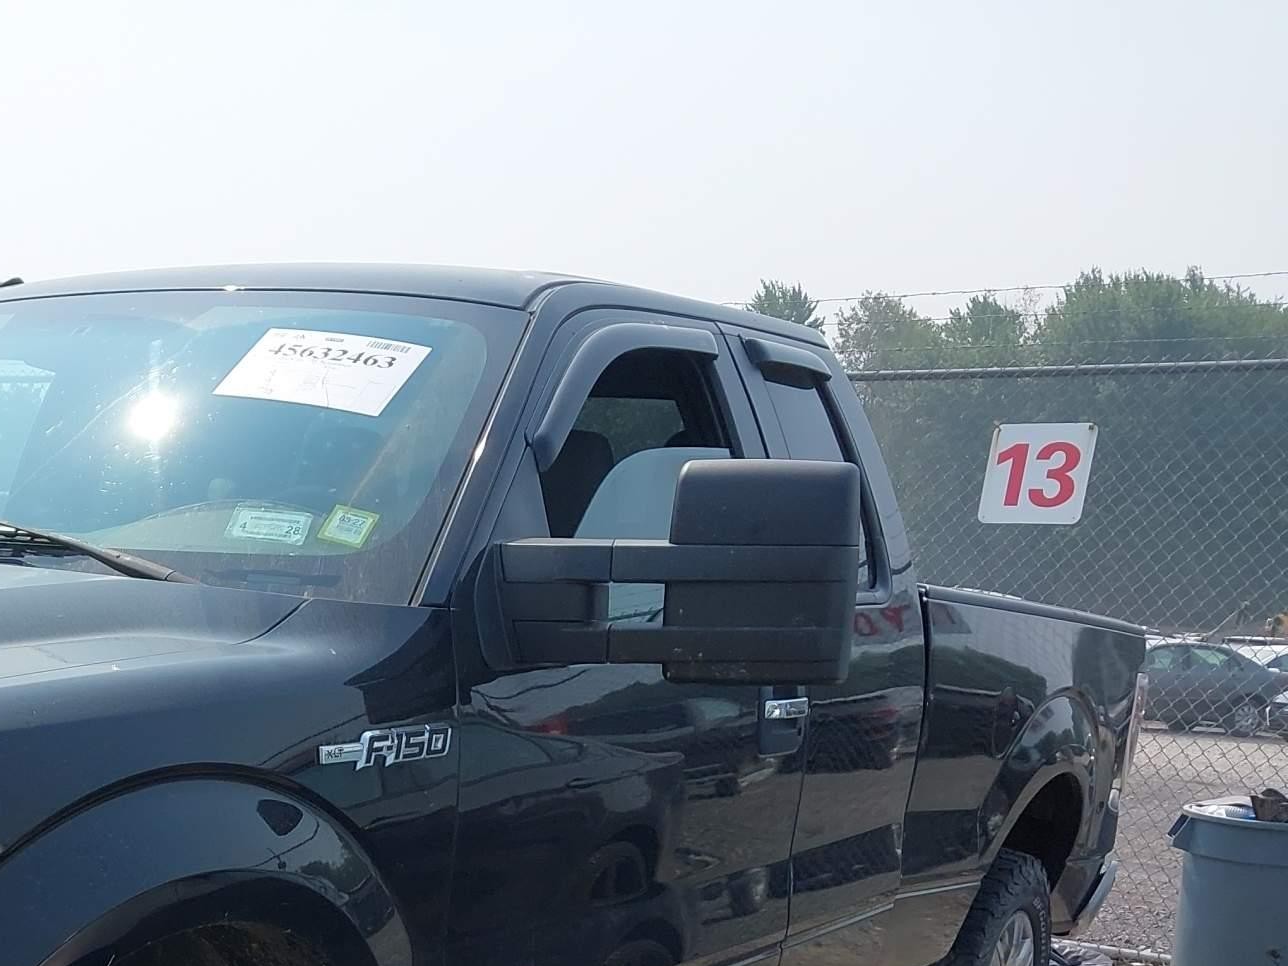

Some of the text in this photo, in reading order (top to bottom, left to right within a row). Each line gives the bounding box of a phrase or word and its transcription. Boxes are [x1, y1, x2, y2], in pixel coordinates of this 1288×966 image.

[268, 343, 398, 369] 45632463
[996, 441, 1081, 508] 13
[285, 525, 301, 536] 28
[325, 747, 345, 759] XLT
